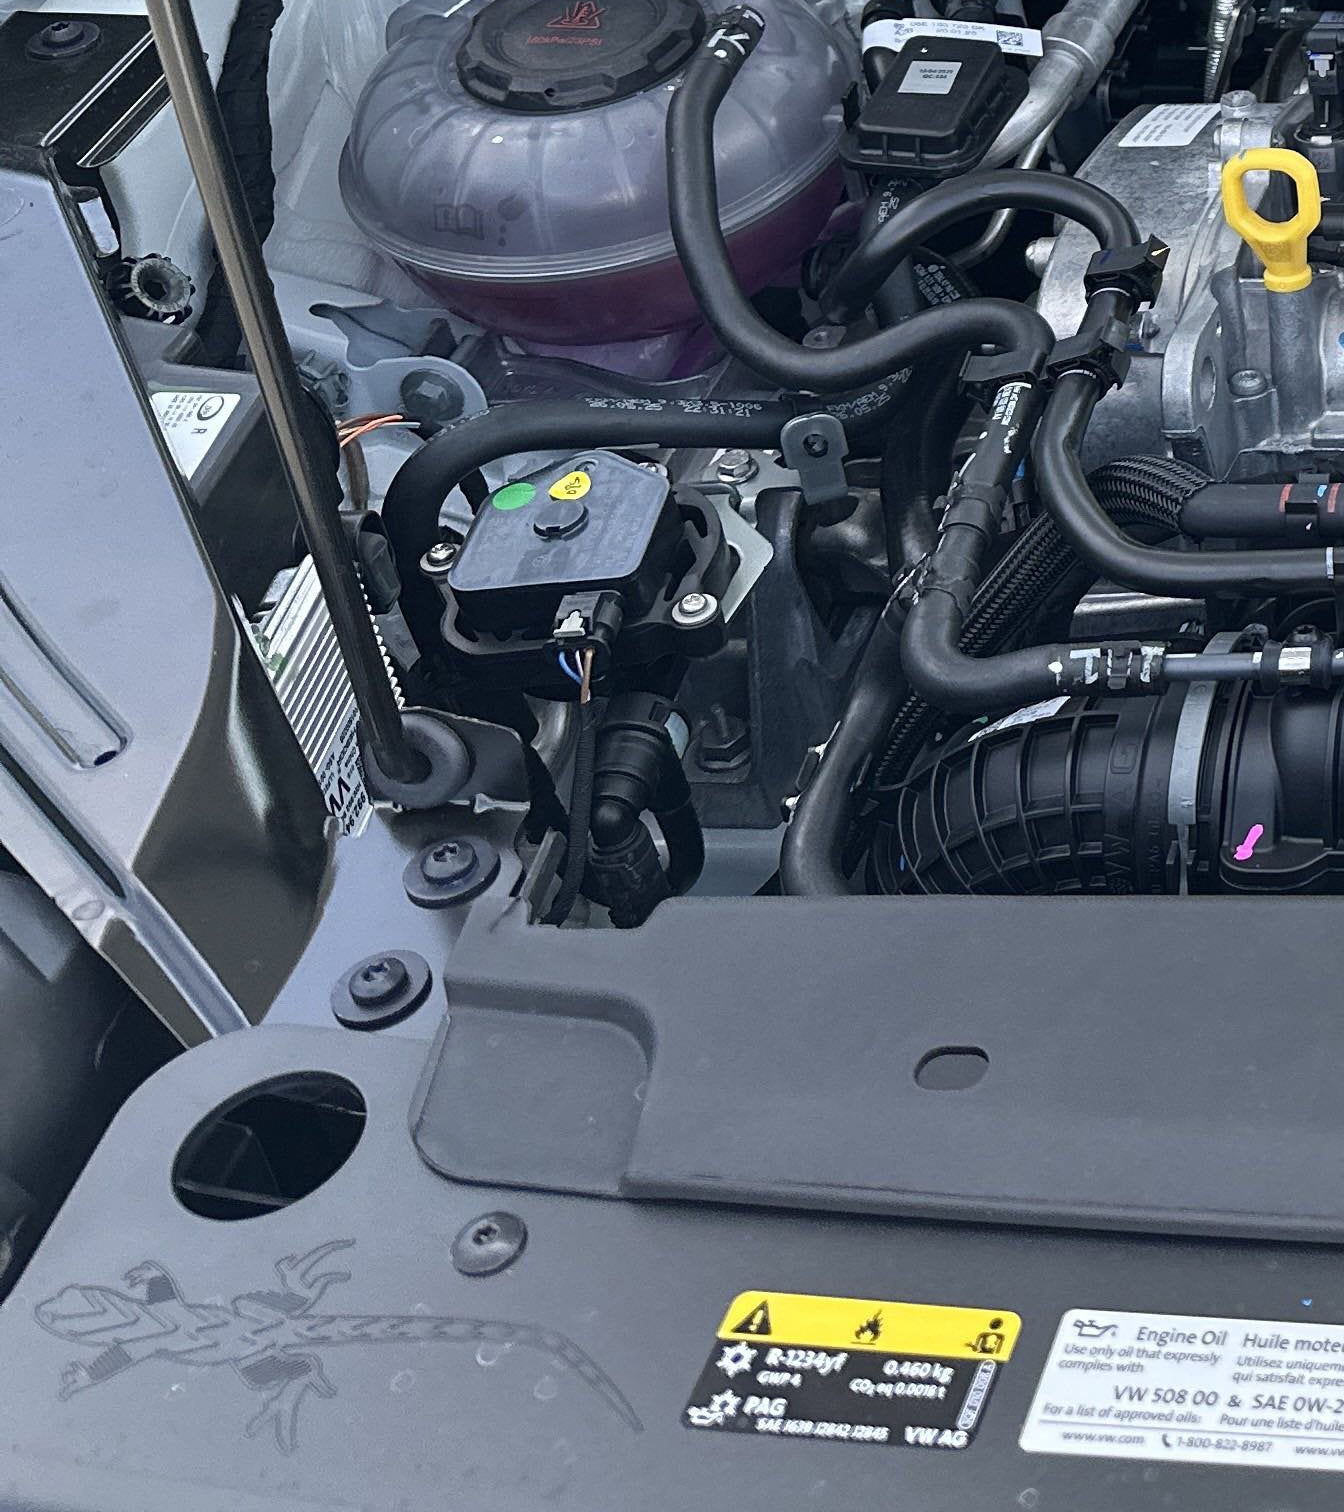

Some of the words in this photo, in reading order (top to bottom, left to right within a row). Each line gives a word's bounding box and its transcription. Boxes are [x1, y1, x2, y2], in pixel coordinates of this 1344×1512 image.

[1136, 1325, 1198, 1347] Engine
[1200, 1329, 1228, 1346] Oil
[1242, 1332, 1290, 1352] Huile
[1064, 1342, 1088, 1356] Use
[1088, 1344, 1115, 1359] only
[1117, 1344, 1134, 1358] oil
[1135, 1346, 1162, 1361] that
[1163, 1350, 1220, 1366] expressly
[1236, 1355, 1283, 1370] Utilisez
[764, 1347, 850, 1376] R-1234yf
[882, 1359, 932, 1379] 0.460
[932, 1362, 954, 1384] kg
[1058, 1358, 1113, 1374] complies
[1115, 1360, 1144, 1374] with
[756, 1370, 789, 1387] GWP
[1232, 1370, 1253, 1384] qui
[1255, 1372, 1305, 1386] satisfait
[875, 1383, 894, 1400] eq
[1112, 1384, 1149, 1403] VW
[1151, 1386, 1188, 1405] 508
[1192, 1389, 1219, 1406] 00
[1227, 1393, 1243, 1409] &
[1251, 1392, 1289, 1412] SAE
[742, 1395, 789, 1417] PAG
[1043, 1401, 1064, 1416] For
[1065, 1405, 1075, 1416] a
[1076, 1403, 1097, 1418] list
[1099, 1405, 1113, 1421] of
[1113, 1408, 1174, 1424] approved
[1175, 1411, 1202, 1425] oils:
[755, 1417, 782, 1432] SAE
[1219, 1412, 1249, 1428] Pour
[1250, 1417, 1275, 1430] une
[1276, 1416, 1301, 1431] liste
[904, 1426, 936, 1446] VW
[937, 1429, 969, 1449] AG
[1062, 1430, 1146, 1446] www.vw.com
[1176, 1436, 1273, 1453] 1-800-822-8987
